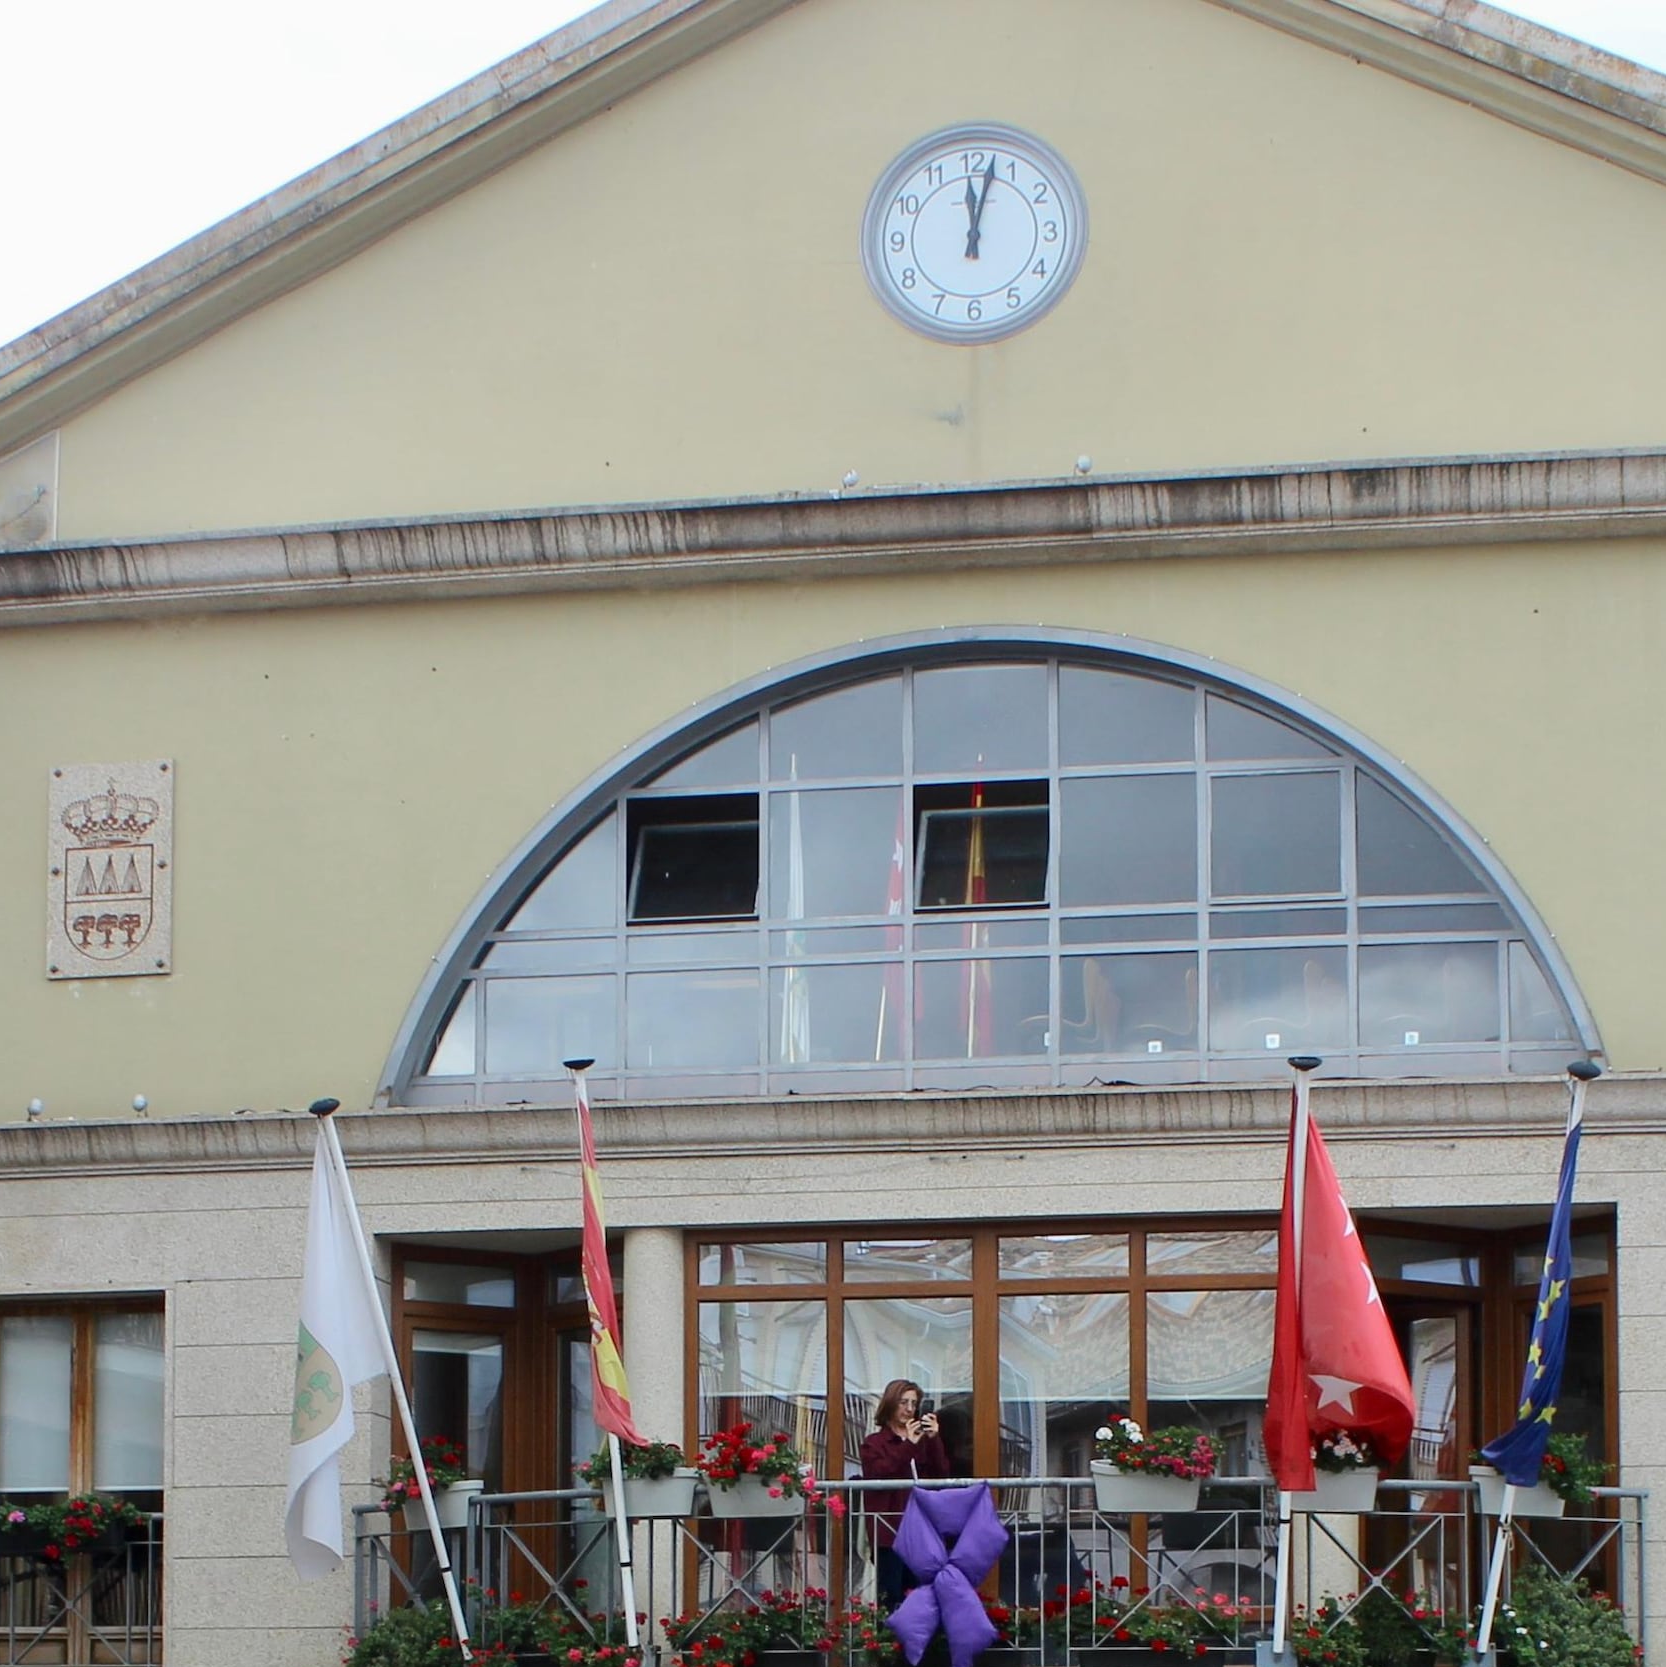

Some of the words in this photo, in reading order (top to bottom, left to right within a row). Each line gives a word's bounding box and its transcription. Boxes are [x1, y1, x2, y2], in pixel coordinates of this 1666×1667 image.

[959, 152, 985, 174] 12
[1006, 161, 1015, 182] 1
[923, 165, 943, 186] 11
[1033, 183, 1048, 204] 2
[896, 195, 919, 216] 10
[890, 232, 905, 252] 9
[1043, 221, 1058, 242] 3
[901, 268, 916, 289] 8
[1032, 258, 1047, 279] 4
[932, 295, 946, 316] 7
[1007, 288, 1021, 309] 5
[967, 300, 982, 320] 6
